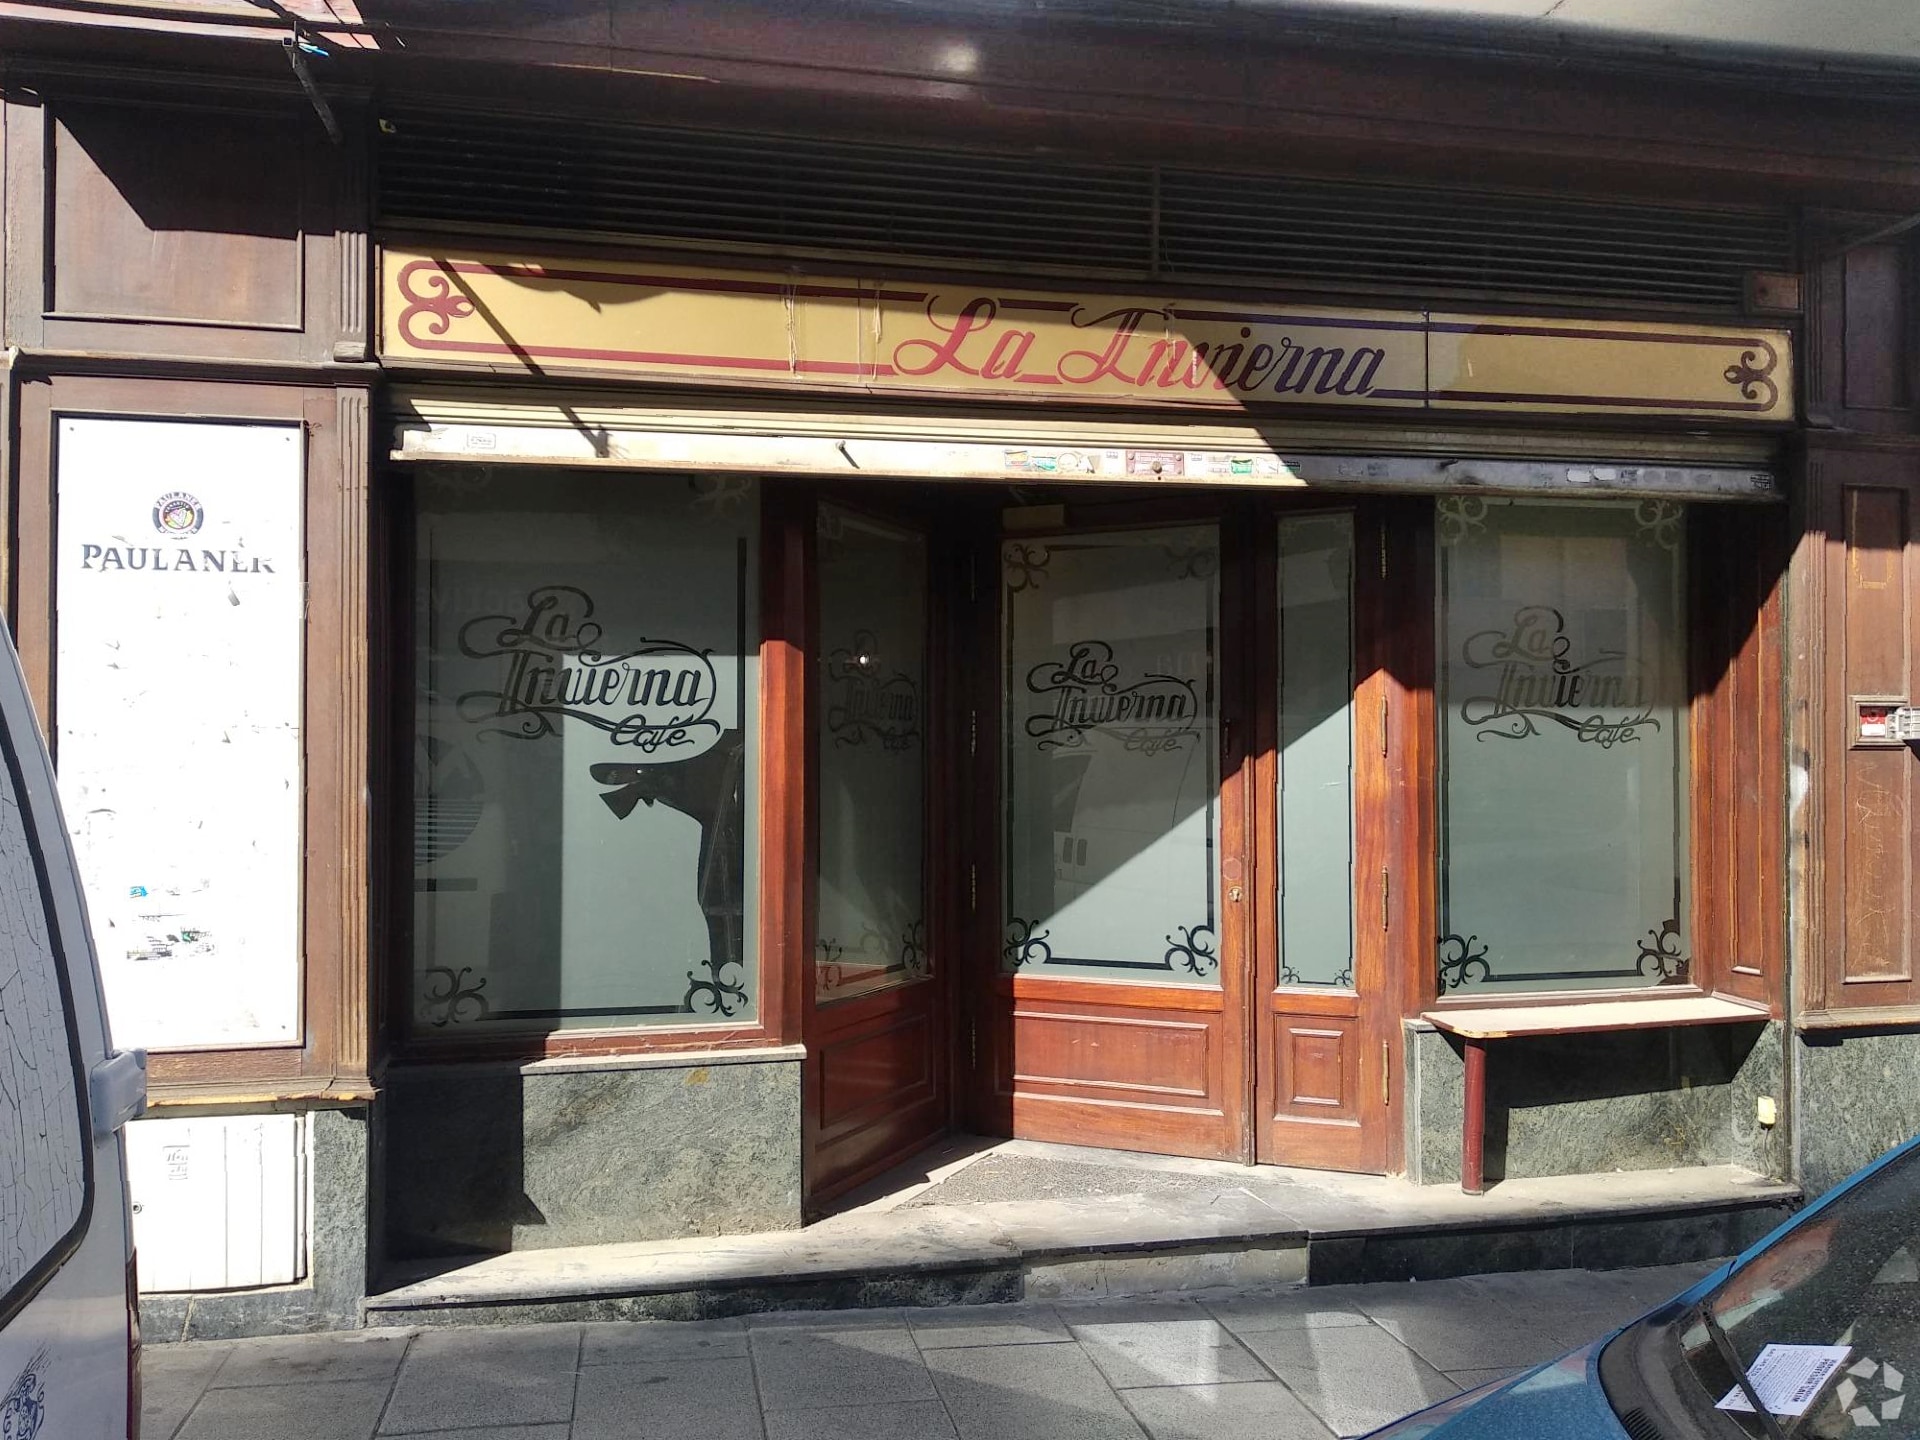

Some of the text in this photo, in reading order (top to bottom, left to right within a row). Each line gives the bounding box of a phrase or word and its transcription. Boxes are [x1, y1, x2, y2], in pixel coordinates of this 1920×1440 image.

[893, 297, 1036, 381] La
[497, 586, 600, 650] La
[1493, 605, 1570, 661] La
[1052, 641, 1118, 686] La
